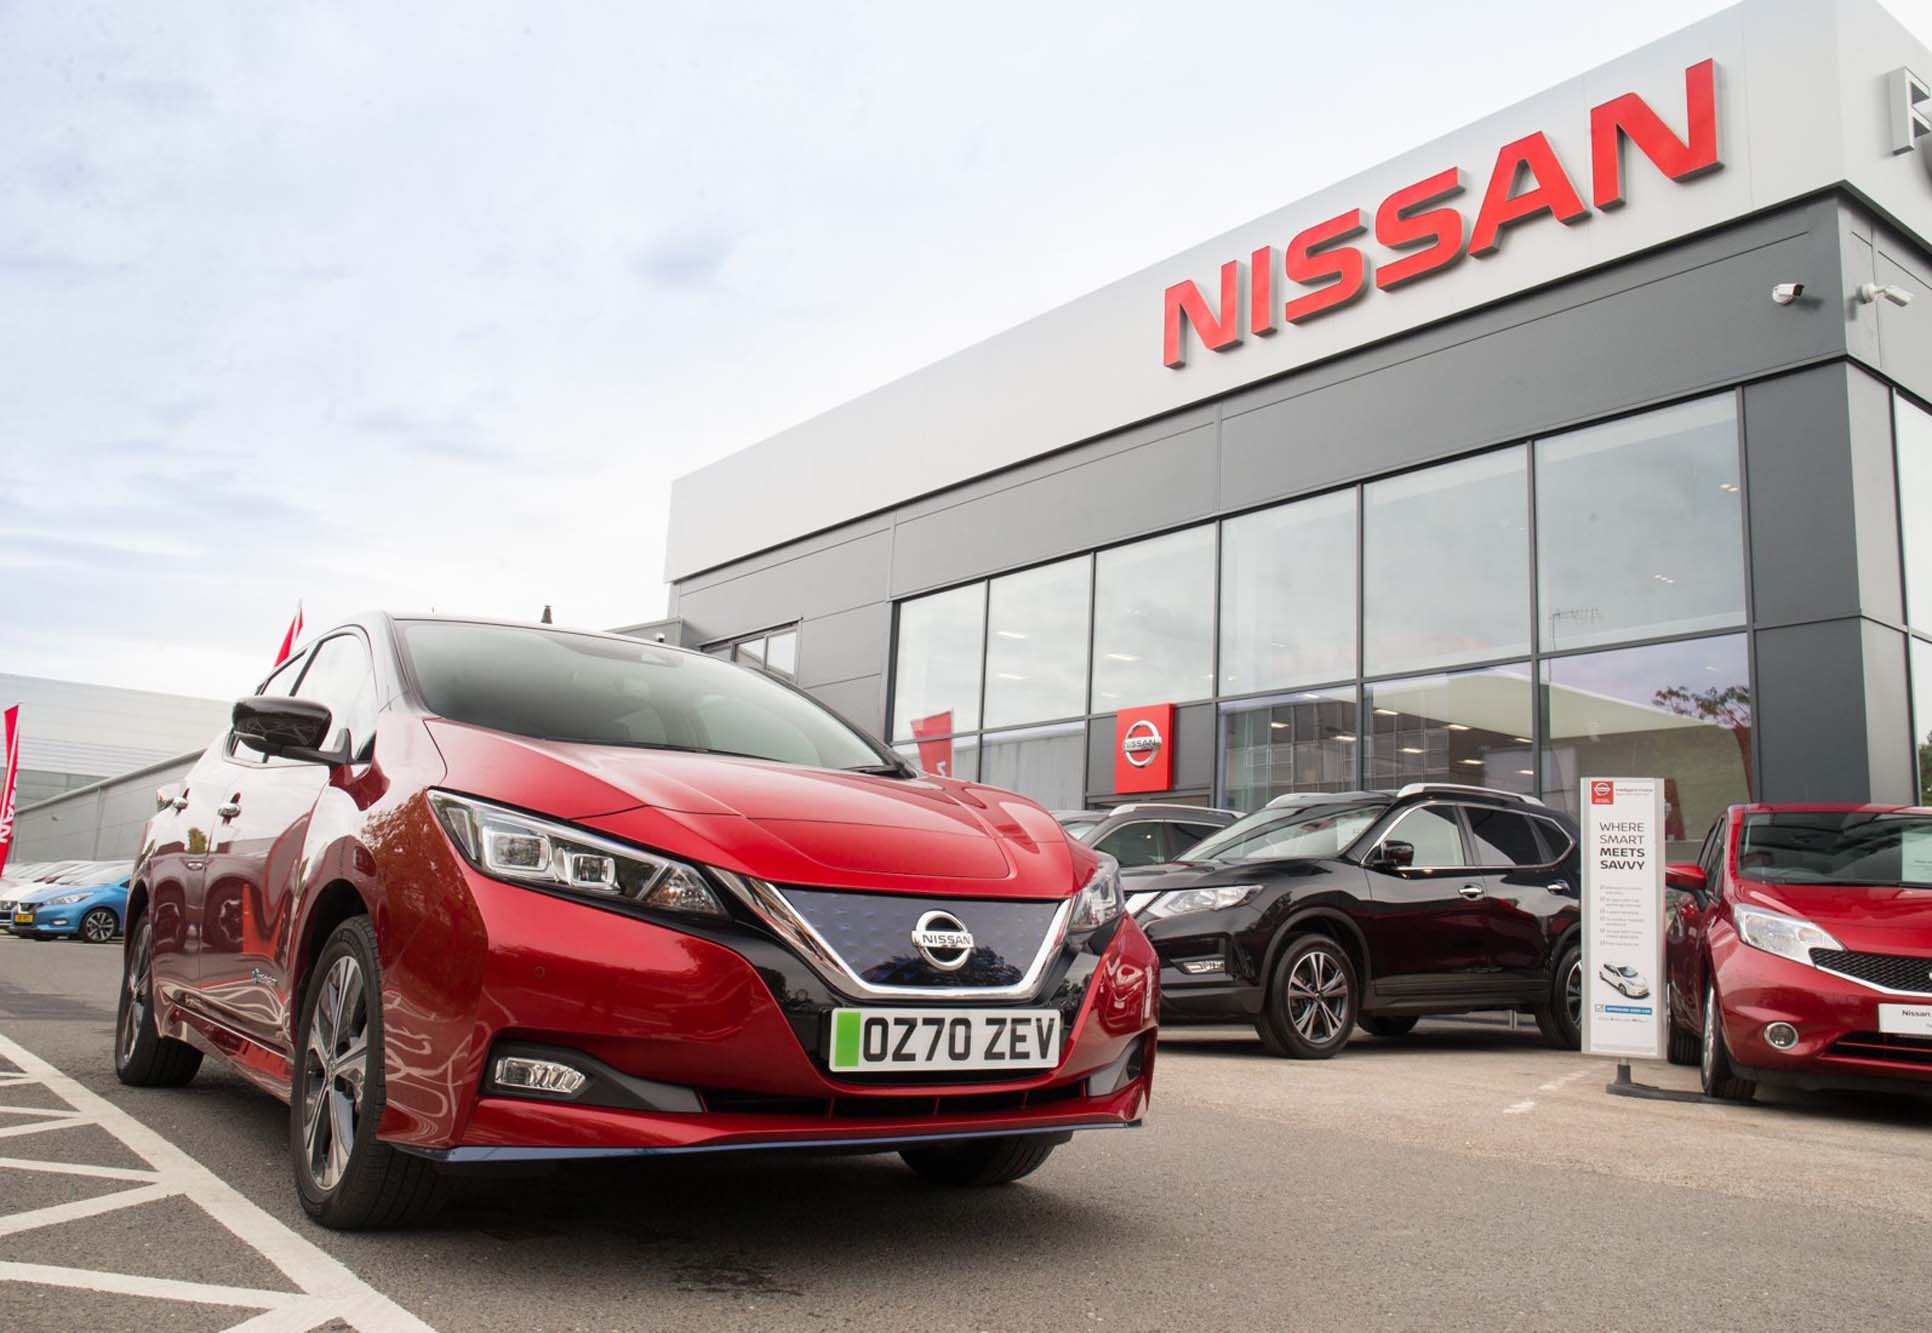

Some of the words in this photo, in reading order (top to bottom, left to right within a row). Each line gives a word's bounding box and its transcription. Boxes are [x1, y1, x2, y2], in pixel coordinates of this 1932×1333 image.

[1163, 58, 1724, 369] NISSAN
[1599, 822, 1645, 833] WHERE
[1599, 834, 1645, 845] SMART
[1599, 847, 1646, 858] MEETS
[1600, 860, 1645, 870] SAVVY
[922, 934, 971, 945] NISSAN
[1902, 1009, 1931, 1017] Nissan
[863, 1017, 972, 1062] OZ70
[984, 1017, 1056, 1061] ZEV
